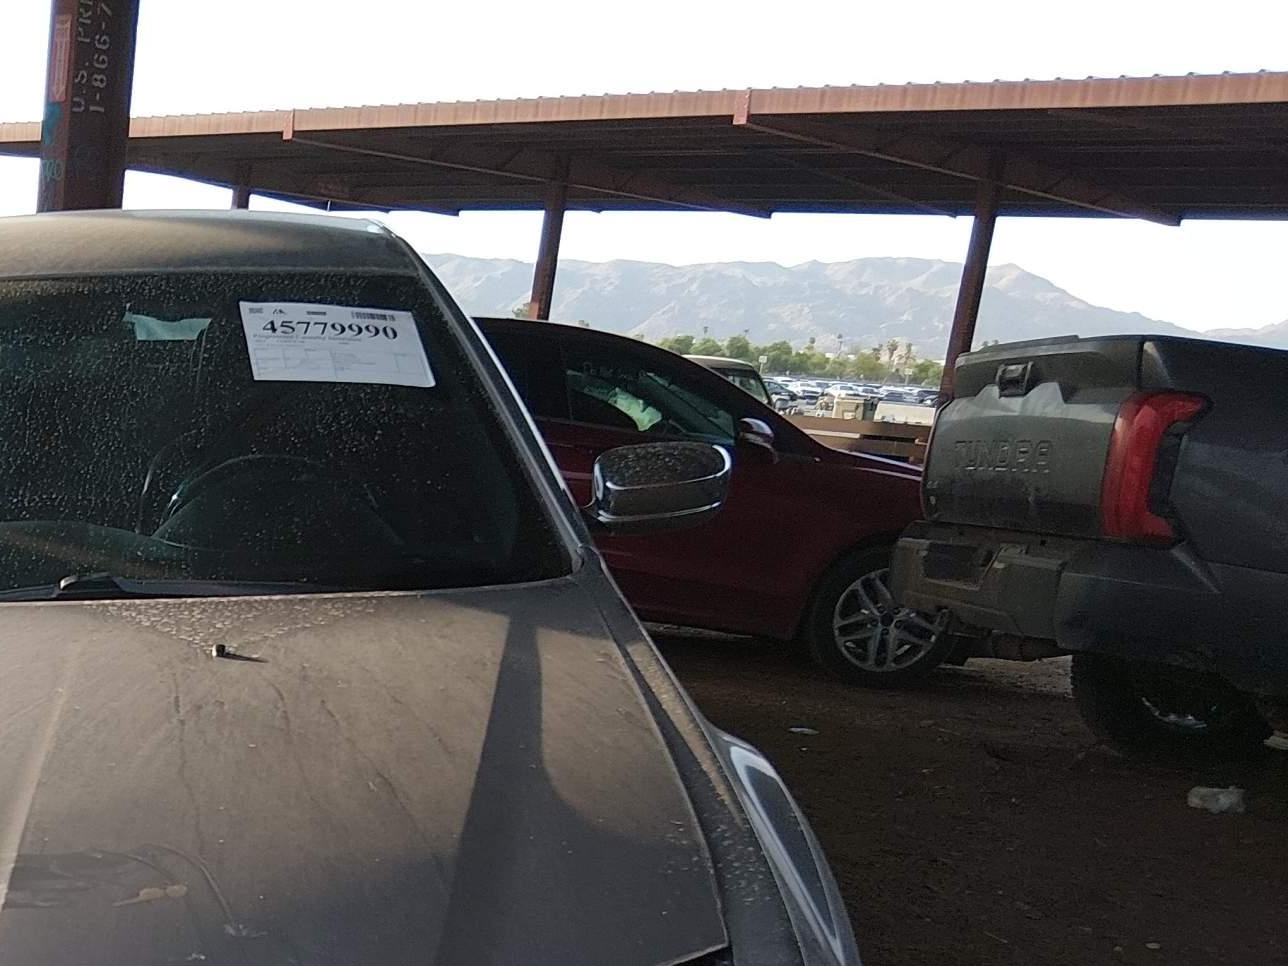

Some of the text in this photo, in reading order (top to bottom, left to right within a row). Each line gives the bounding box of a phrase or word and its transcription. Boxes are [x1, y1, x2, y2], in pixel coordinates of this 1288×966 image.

[71, 61, 89, 113] U.S.
[262, 319, 398, 340] 45779990
[954, 439, 1053, 474] TUNDRA
